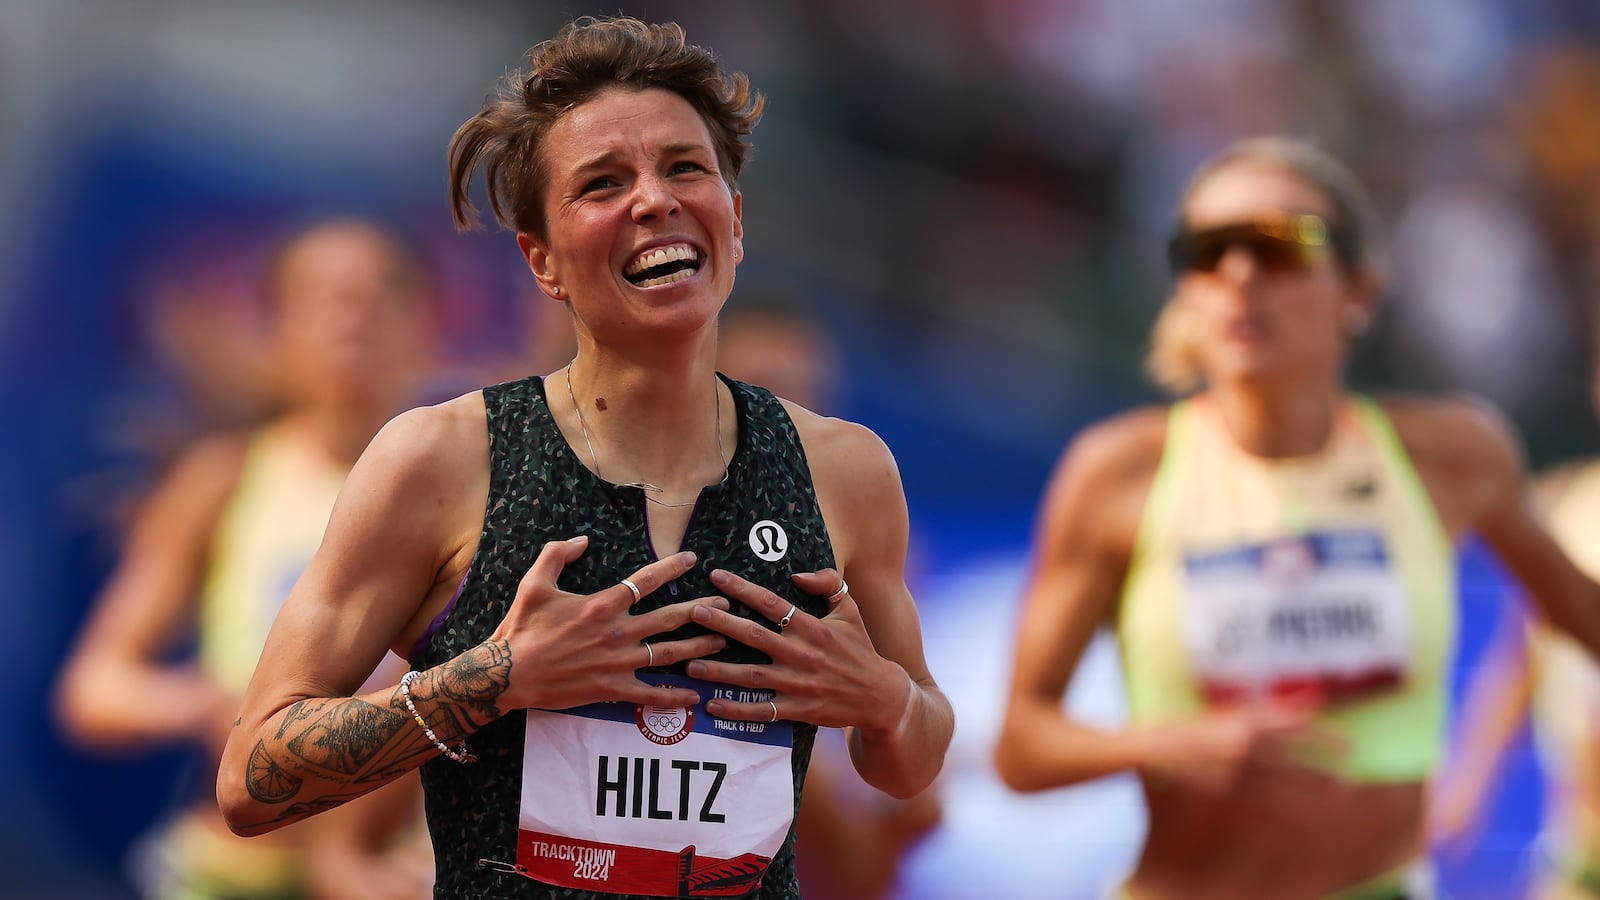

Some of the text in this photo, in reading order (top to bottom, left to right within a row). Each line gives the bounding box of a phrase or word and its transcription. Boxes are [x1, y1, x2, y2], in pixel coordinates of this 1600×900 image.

[641, 726, 687, 744] OLYMPIC TEAM
[714, 719, 764, 733] TRACK & FIELD
[596, 755, 727, 823] HILTZ
[532, 841, 616, 866] TRACKTOWN
[573, 861, 609, 881] 2024
